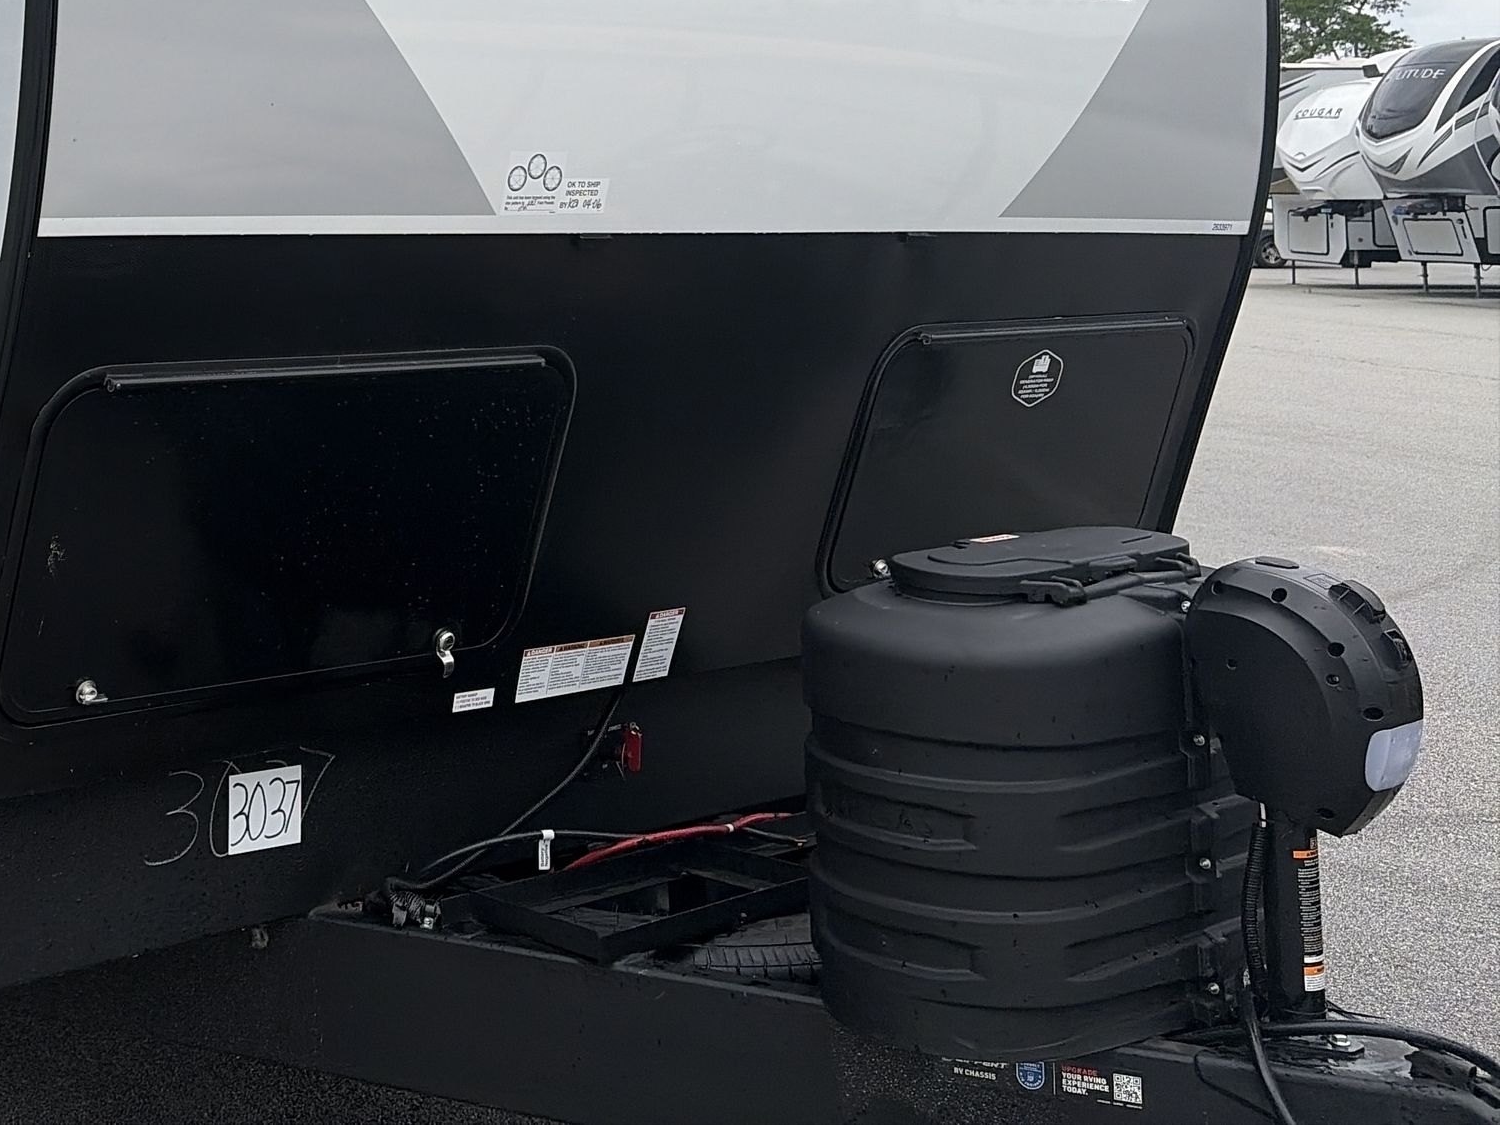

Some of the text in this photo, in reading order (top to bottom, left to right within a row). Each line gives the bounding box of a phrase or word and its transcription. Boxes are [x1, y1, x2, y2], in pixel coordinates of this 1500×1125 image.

[1294, 107, 1343, 119] COUGAR
[587, 180, 601, 188] SHIP
[565, 189, 599, 197] INSPECTED
[231, 776, 301, 847] 3037
[953, 1066, 997, 1081] RV CHASSIS
[1061, 1065, 1098, 1076] UPGRADE
[1061, 1072, 1107, 1085] YOUR RVING
[1061, 1078, 1110, 1093] EXPERIENCE
[1061, 1085, 1089, 1096] TODAY.
